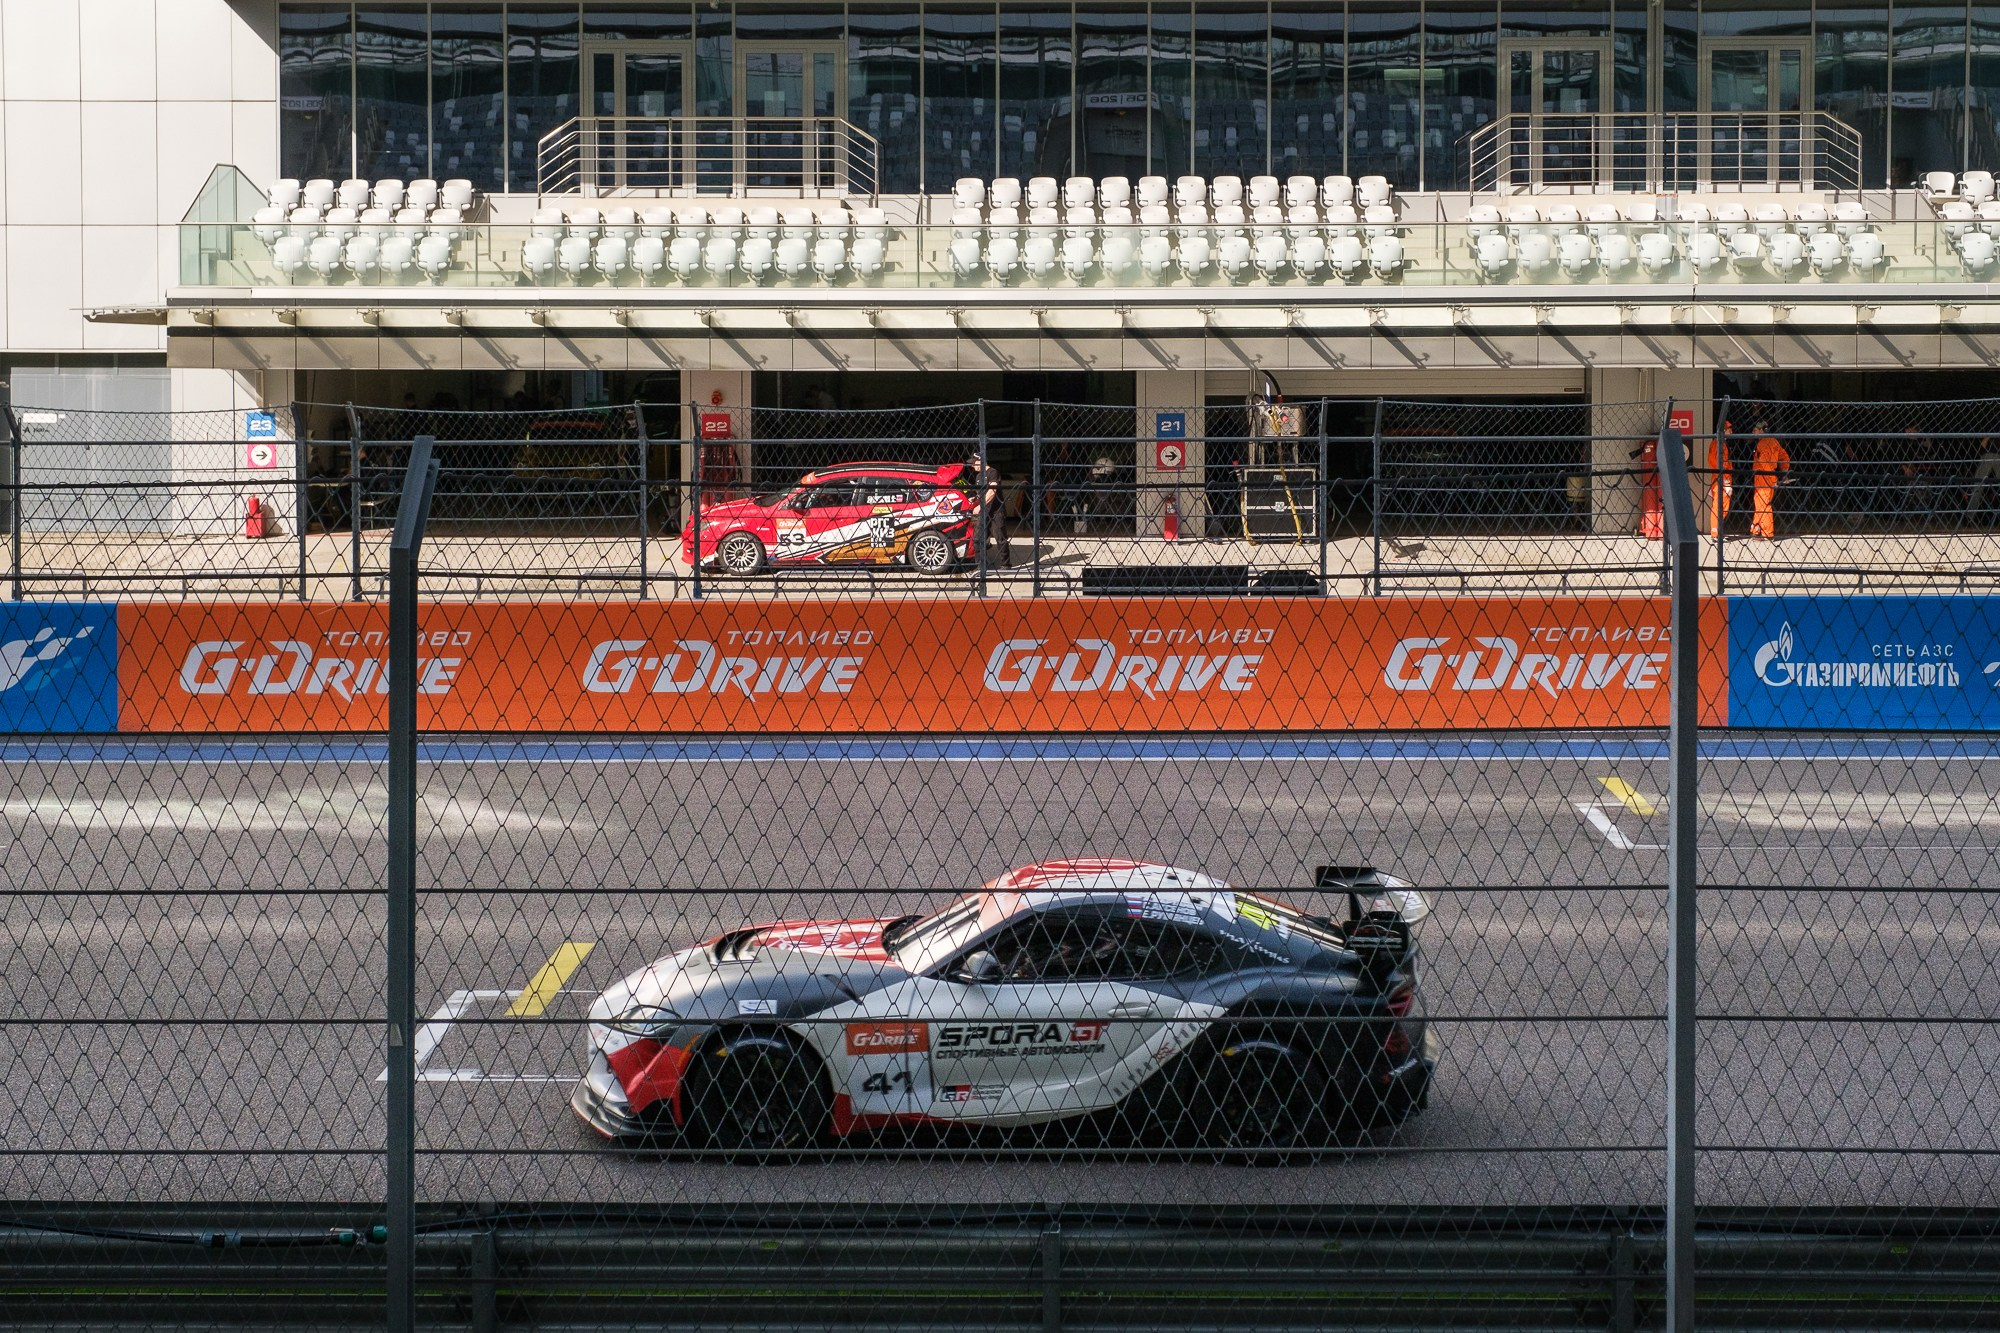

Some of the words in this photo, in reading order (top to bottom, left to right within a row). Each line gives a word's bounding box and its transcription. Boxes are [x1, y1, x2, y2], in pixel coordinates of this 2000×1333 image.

[250, 419, 272, 431] 23
[705, 421, 728, 432] 22
[1160, 420, 1181, 432] 21
[1668, 418, 1690, 429] 20
[779, 532, 806, 547] 53
[322, 631, 472, 646] ТОПВО
[727, 630, 874, 646] ТОПЛИВО
[1126, 628, 1275, 644] ТОПЛИВО
[1872, 644, 1916, 657] СЕТЬ
[1920, 644, 1955, 657] АЗС
[938, 1023, 1063, 1047] SPORA
[935, 1046, 1018, 1060] СПОРТИВНЫЕ
[1020, 1043, 1106, 1056] АВТОМОБИЛИ
[862, 1071, 913, 1095] 41
